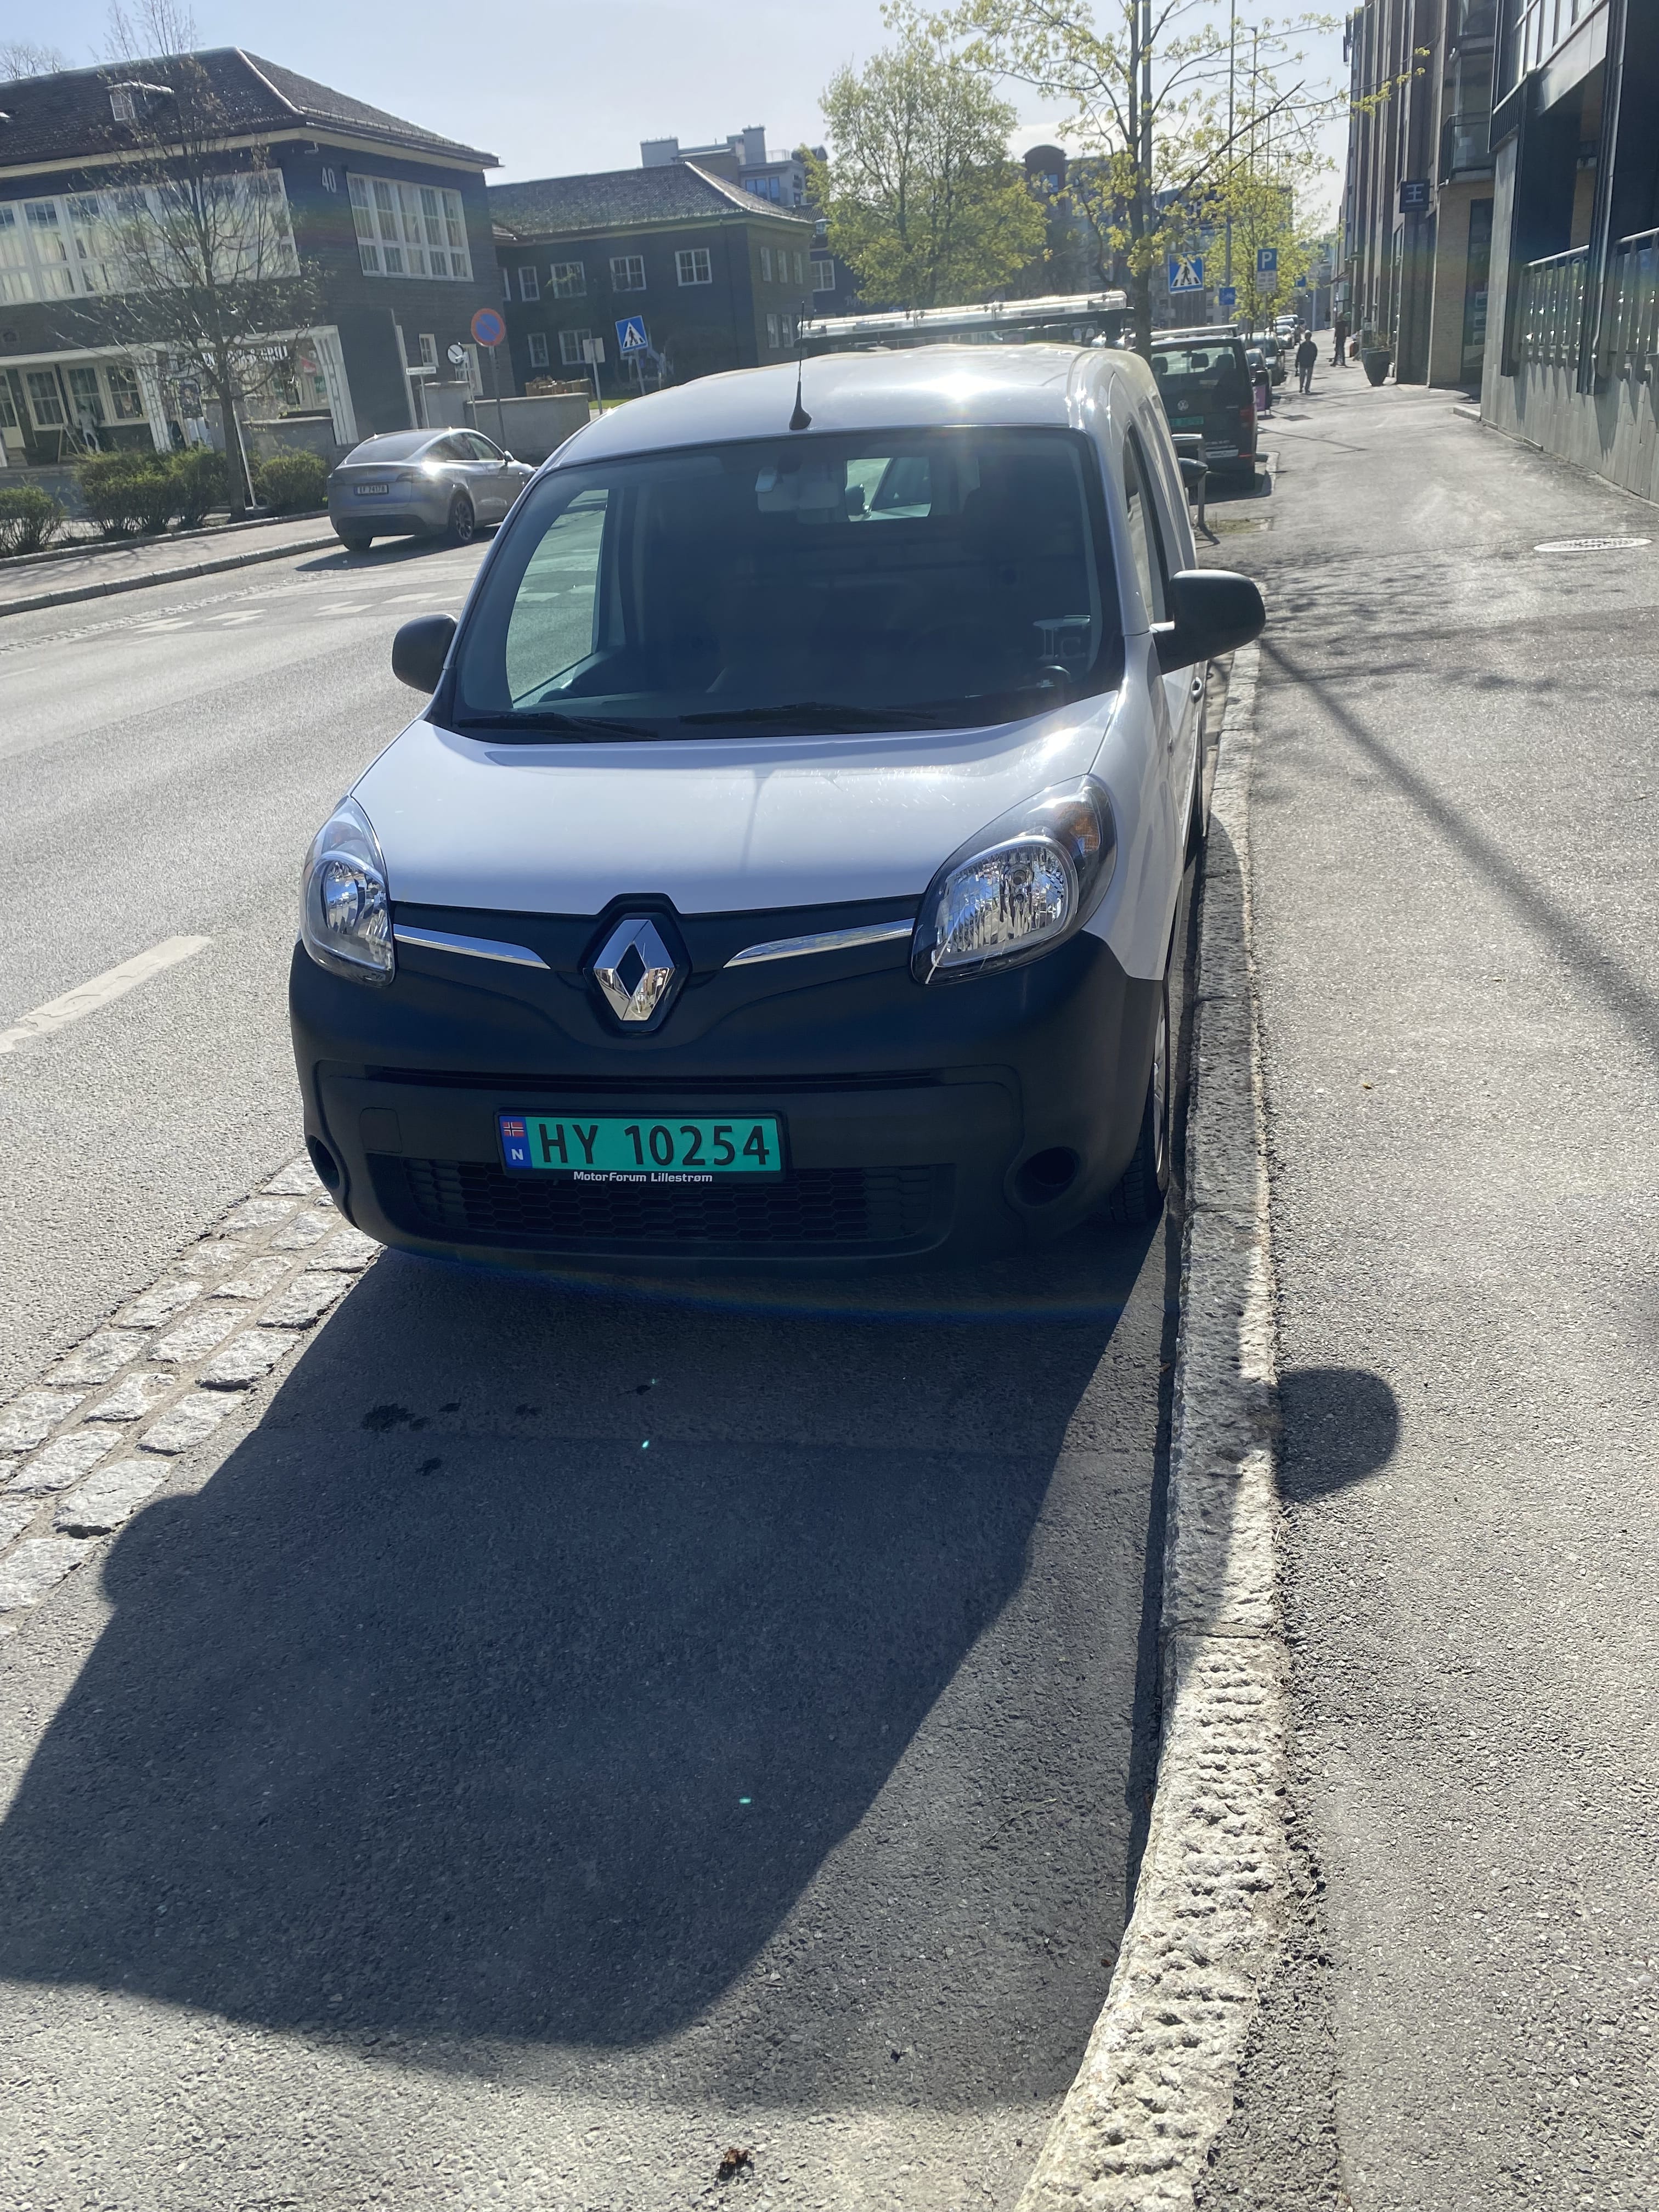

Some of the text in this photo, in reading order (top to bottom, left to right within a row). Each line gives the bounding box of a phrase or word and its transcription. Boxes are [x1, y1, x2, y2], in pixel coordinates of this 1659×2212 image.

[322, 167, 336, 193] 40
[1262, 251, 1272, 269] P
[539, 1124, 769, 1165] HY 10254
[511, 1149, 523, 1160] N
[651, 1173, 712, 1182] Lillestrøm
